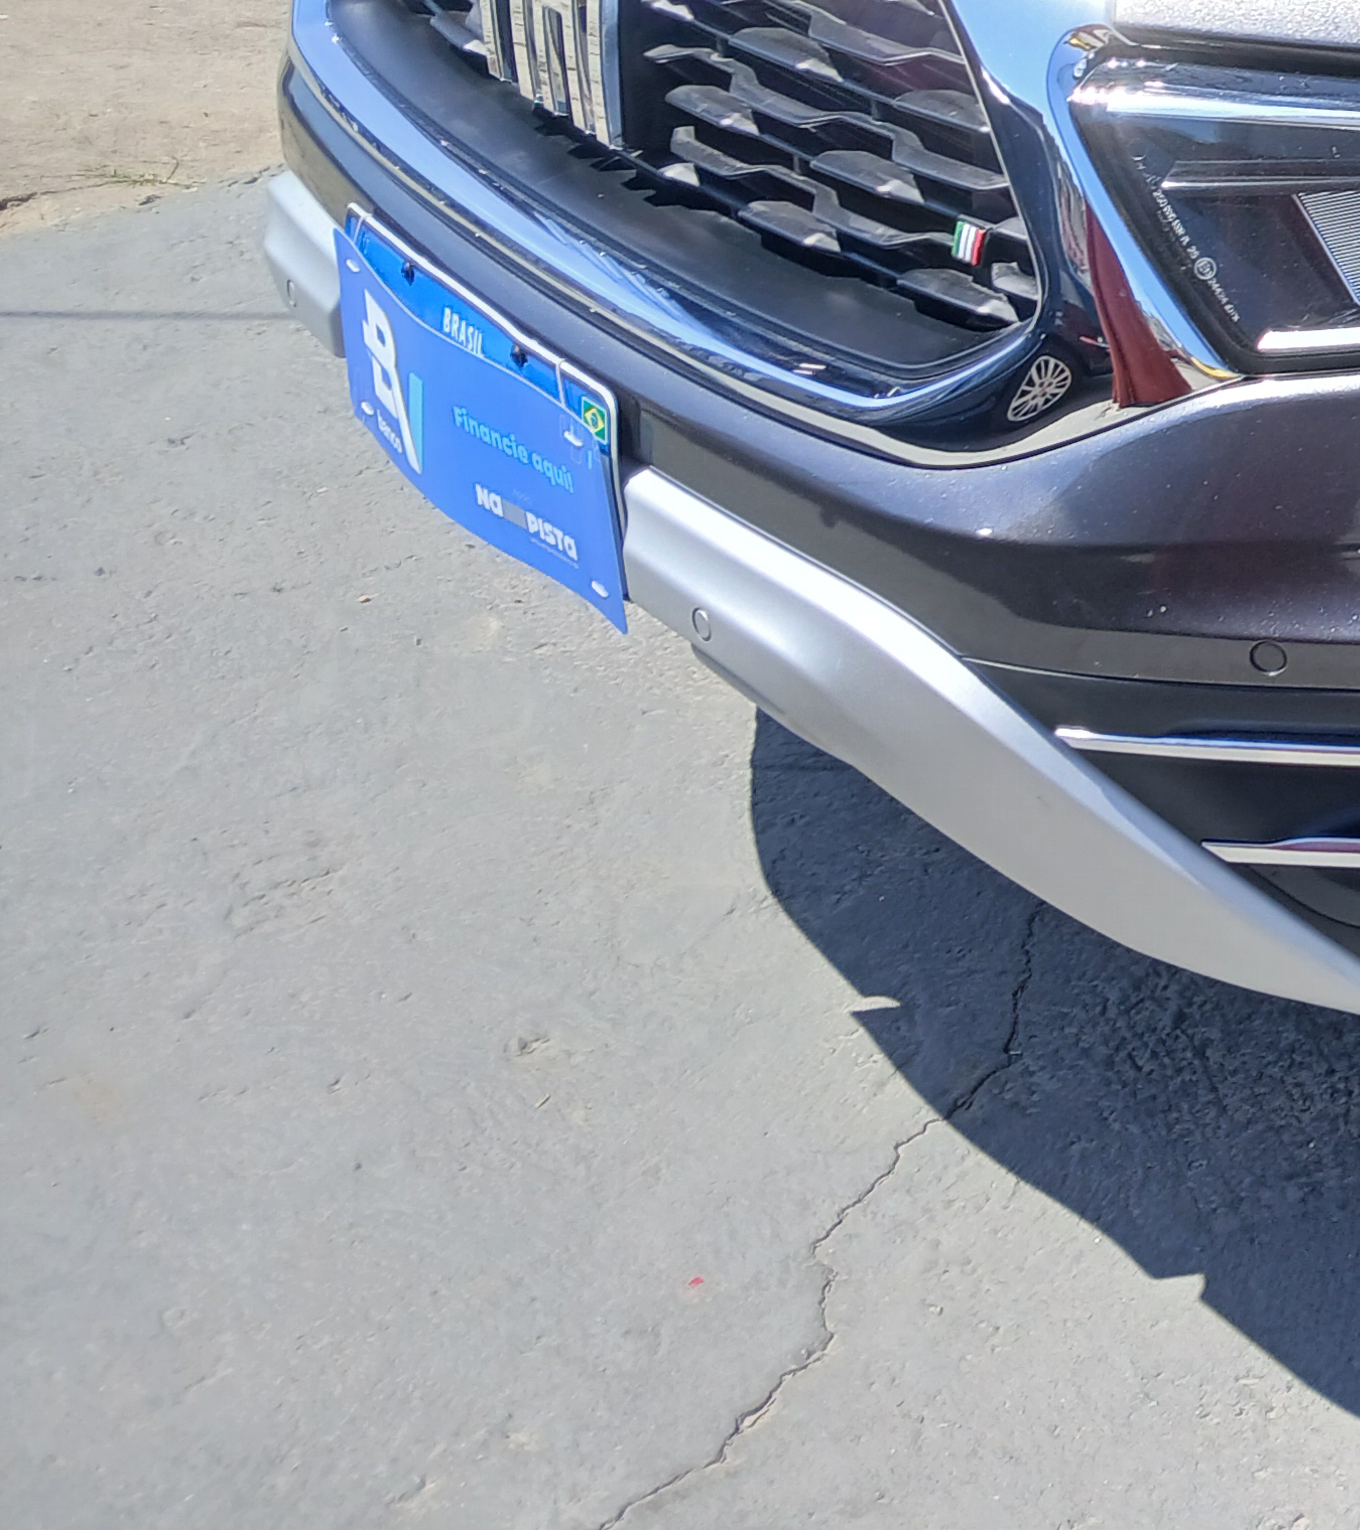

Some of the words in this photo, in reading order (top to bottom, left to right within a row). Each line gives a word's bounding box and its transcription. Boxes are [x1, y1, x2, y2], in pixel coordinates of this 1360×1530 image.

[442, 307, 484, 358] BRASIL
[453, 406, 528, 464] Financie
[531, 452, 574, 494] aqui!
